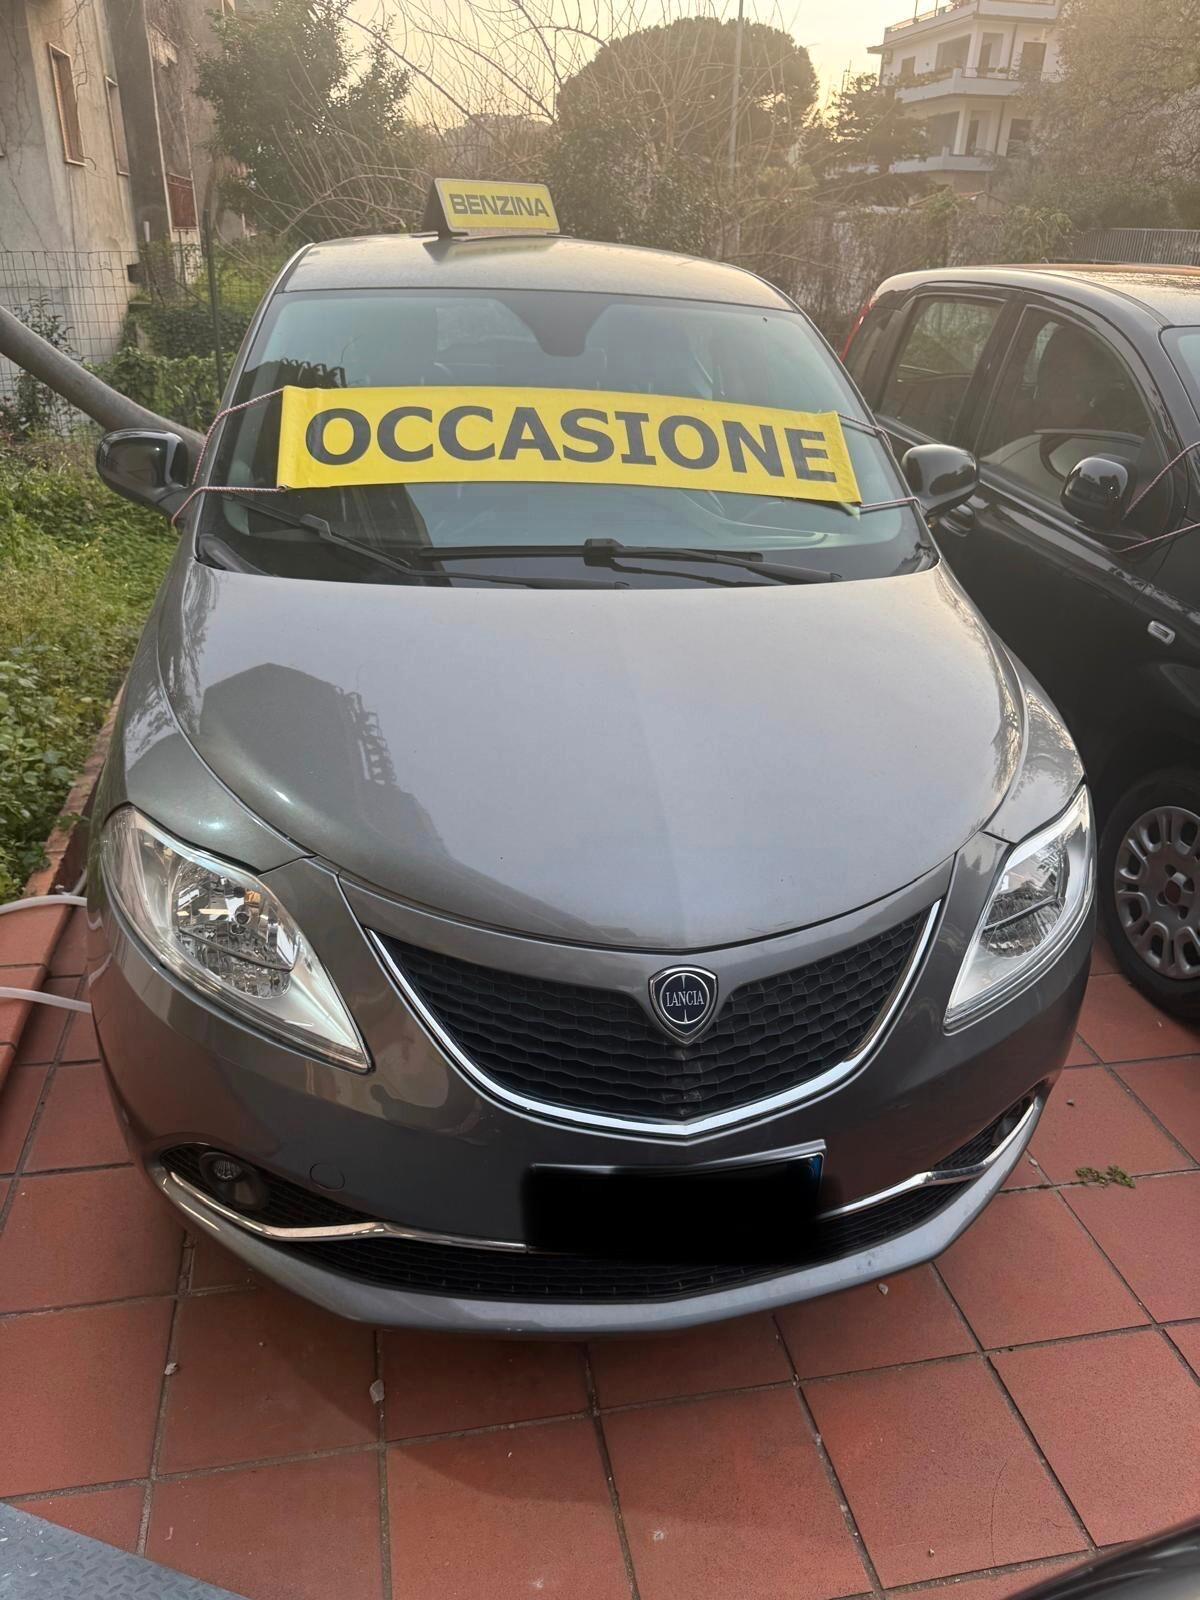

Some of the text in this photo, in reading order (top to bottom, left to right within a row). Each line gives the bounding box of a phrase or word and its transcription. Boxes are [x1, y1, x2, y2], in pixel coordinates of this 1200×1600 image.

[449, 193, 550, 217] BENZINA
[305, 405, 837, 483] OCCASIONE
[665, 990, 705, 1007] LANCIA
